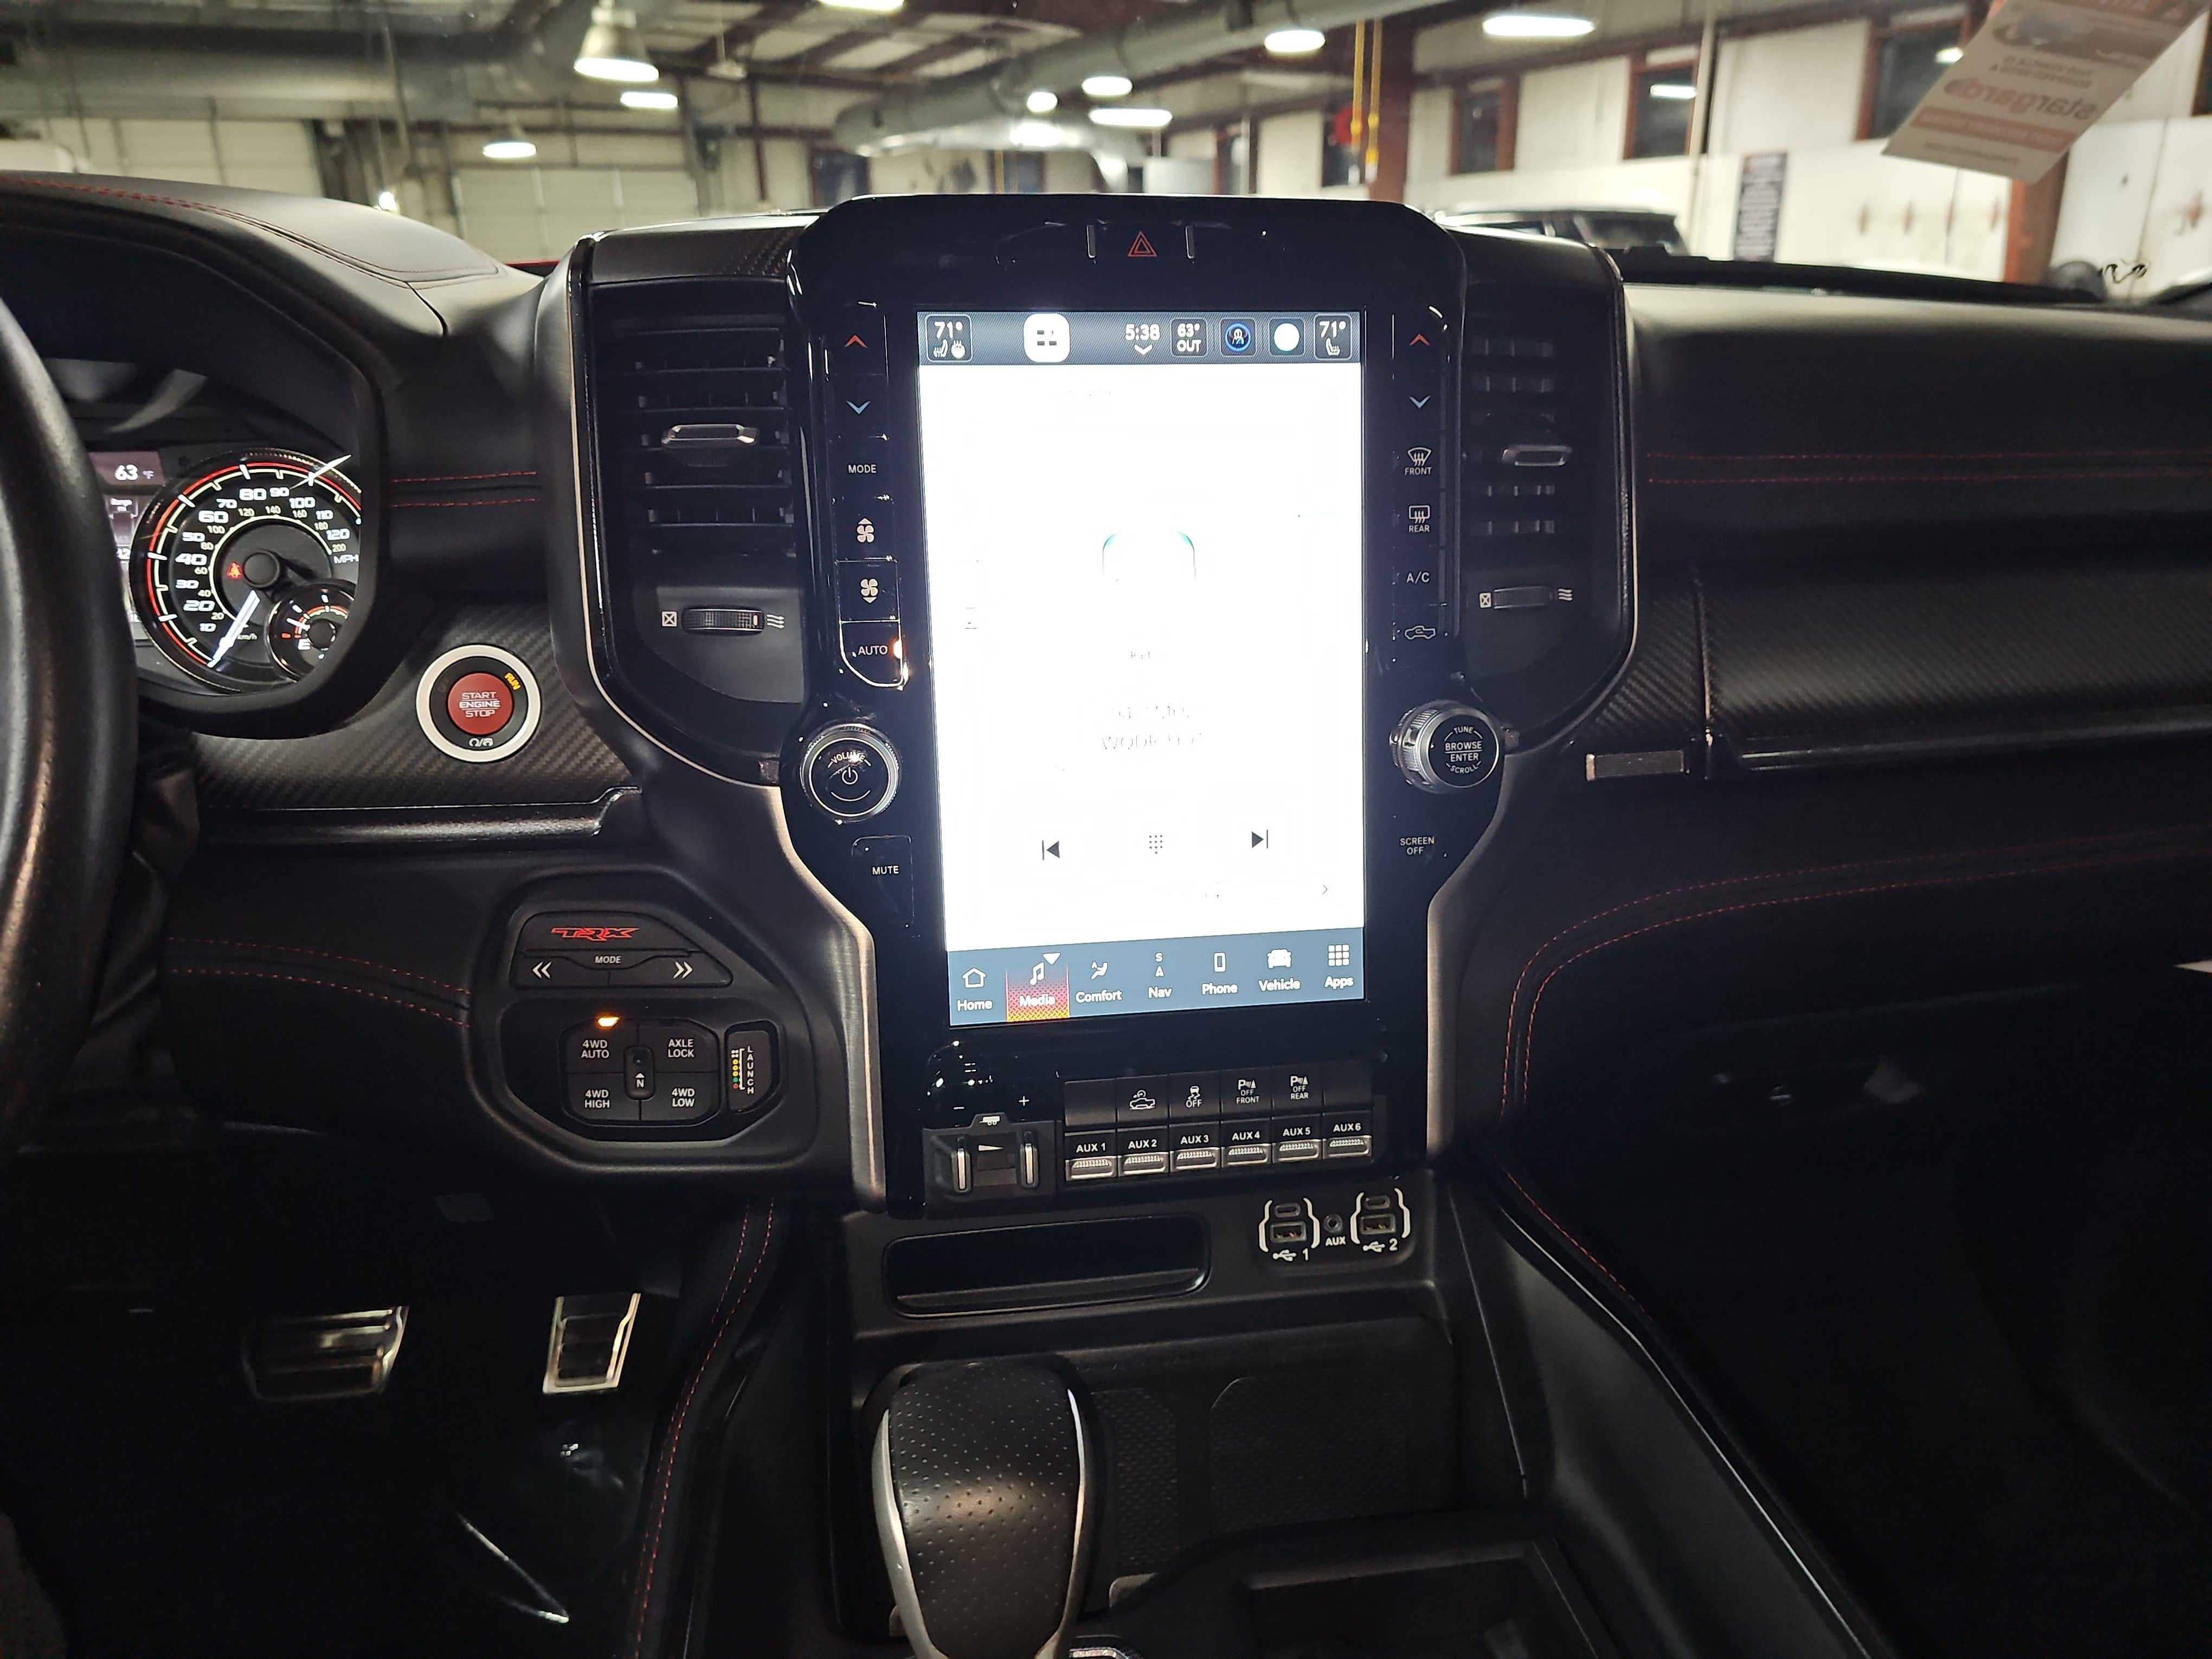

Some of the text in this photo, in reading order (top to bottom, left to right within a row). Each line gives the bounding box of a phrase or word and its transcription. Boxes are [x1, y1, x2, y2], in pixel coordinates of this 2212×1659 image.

[934, 320, 963, 339] 71°
[1124, 324, 1161, 341] 5:38
[1319, 320, 1346, 338] 71°
[1176, 339, 1202, 353] OUT
[114, 464, 139, 481] 63
[847, 464, 877, 474] MODE
[1404, 467, 1432, 476] FRONT
[239, 488, 267, 501] 80
[269, 487, 290, 497] 90
[216, 498, 237, 509] 70
[289, 497, 316, 509] 100
[239, 508, 255, 517] 120
[265, 505, 281, 514] 140
[293, 510, 307, 518] 160
[198, 510, 229, 524] 60
[316, 510, 333, 520] 110
[207, 525, 226, 534] 100
[1409, 524, 1430, 533] REAR
[182, 532, 205, 542] 50
[326, 529, 350, 541] 120
[332, 543, 346, 552] 200
[175, 553, 208, 565] 40
[333, 554, 359, 564] MPH
[1406, 571, 1430, 583] A/C
[175, 580, 199, 589] 30
[183, 600, 216, 612] 20
[200, 623, 216, 632] 10
[858, 645, 888, 655] AUTO
[505, 673, 521, 690] RUN
[1453, 725, 1474, 735] TUNE
[1445, 740, 1482, 751] BROWSE
[1450, 753, 1479, 763] ENTER
[1450, 763, 1479, 774] SCROLL
[1399, 836, 1435, 846] SCREEN
[1406, 846, 1424, 856] OFF
[872, 865, 899, 875] MUTE
[551, 928, 640, 942] TRX
[595, 956, 622, 964] MODE
[1258, 977, 1301, 992] Vehicle
[1323, 975, 1354, 989] Apps
[1148, 986, 1173, 999] Nav
[1201, 982, 1239, 995] Phone
[1019, 993, 1056, 1007] Media
[1076, 989, 1123, 1004] Comfort
[957, 999, 993, 1012] Home
[582, 1039, 608, 1049] 4WD
[668, 1038, 694, 1048] AXLE
[581, 1049, 610, 1059] AUTO
[667, 1049, 695, 1058] LOCK
[636, 1079, 645, 1088] N
[585, 1089, 609, 1098] 4WD
[672, 1088, 695, 1097] 4WD
[1290, 1092, 1309, 1100] REAR
[584, 1099, 610, 1109] HIGH
[672, 1098, 695, 1107] LOW
[1186, 1099, 1203, 1108] OFF
[1236, 1096, 1260, 1104] FRONT
[1283, 1127, 1311, 1137] AUX 5
[1333, 1123, 1361, 1133] AUX 6
[1180, 1134, 1210, 1144] AUX 3
[1232, 1130, 1261, 1141] AUX 4
[1076, 1142, 1106, 1153] AUX 1
[1128, 1139, 1158, 1149] AUX 2
[1325, 1236, 1346, 1246] AUX
[1389, 1238, 1398, 1251] 2
[1302, 1248, 1309, 1261] 1
